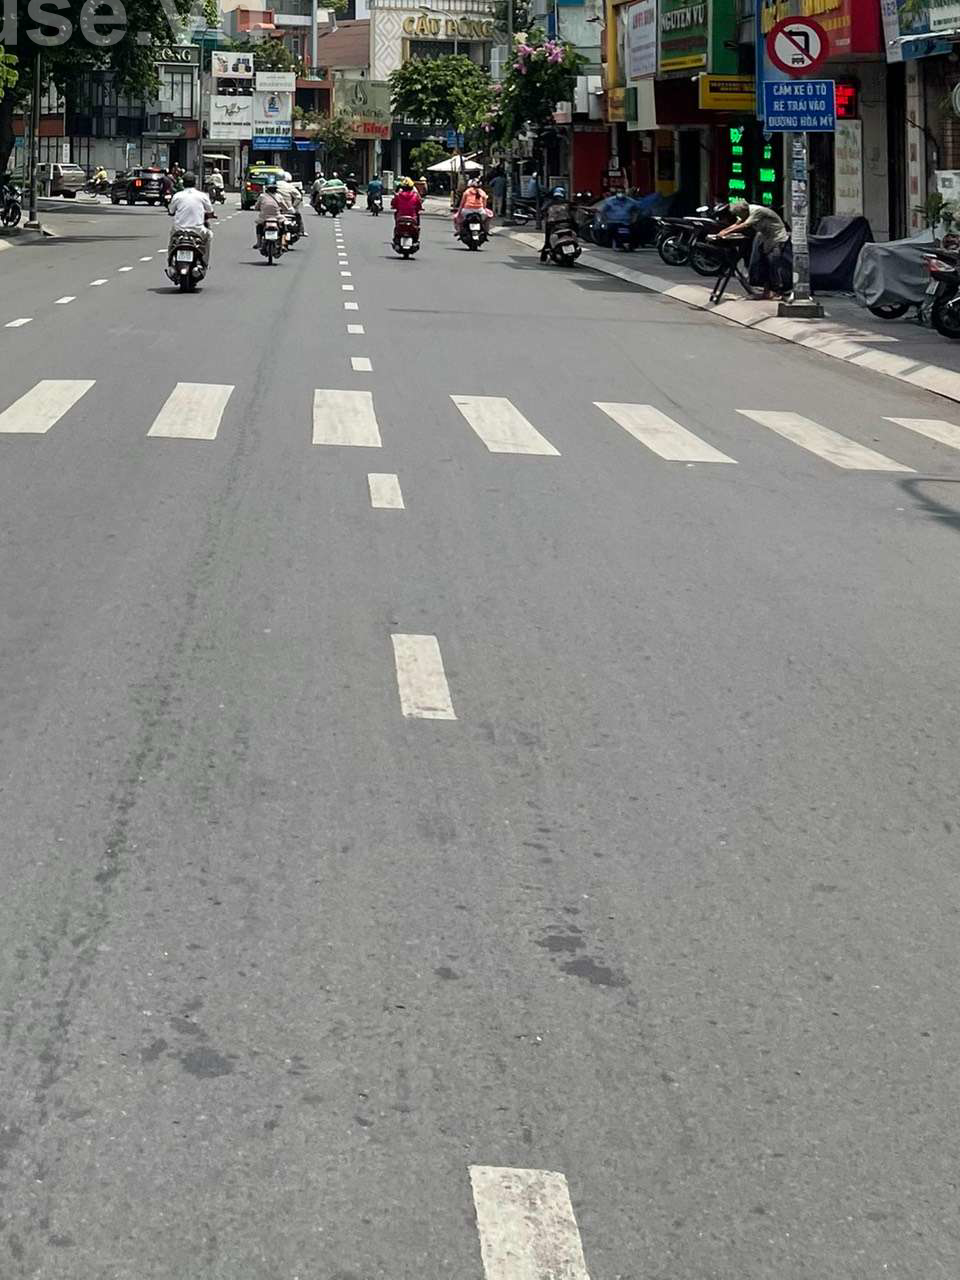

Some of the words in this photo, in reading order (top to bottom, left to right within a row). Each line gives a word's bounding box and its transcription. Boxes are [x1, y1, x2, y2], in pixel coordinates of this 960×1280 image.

[794, 85, 805, 95] XE
[806, 83, 814, 95] Ô
[816, 83, 827, 95] TÔ
